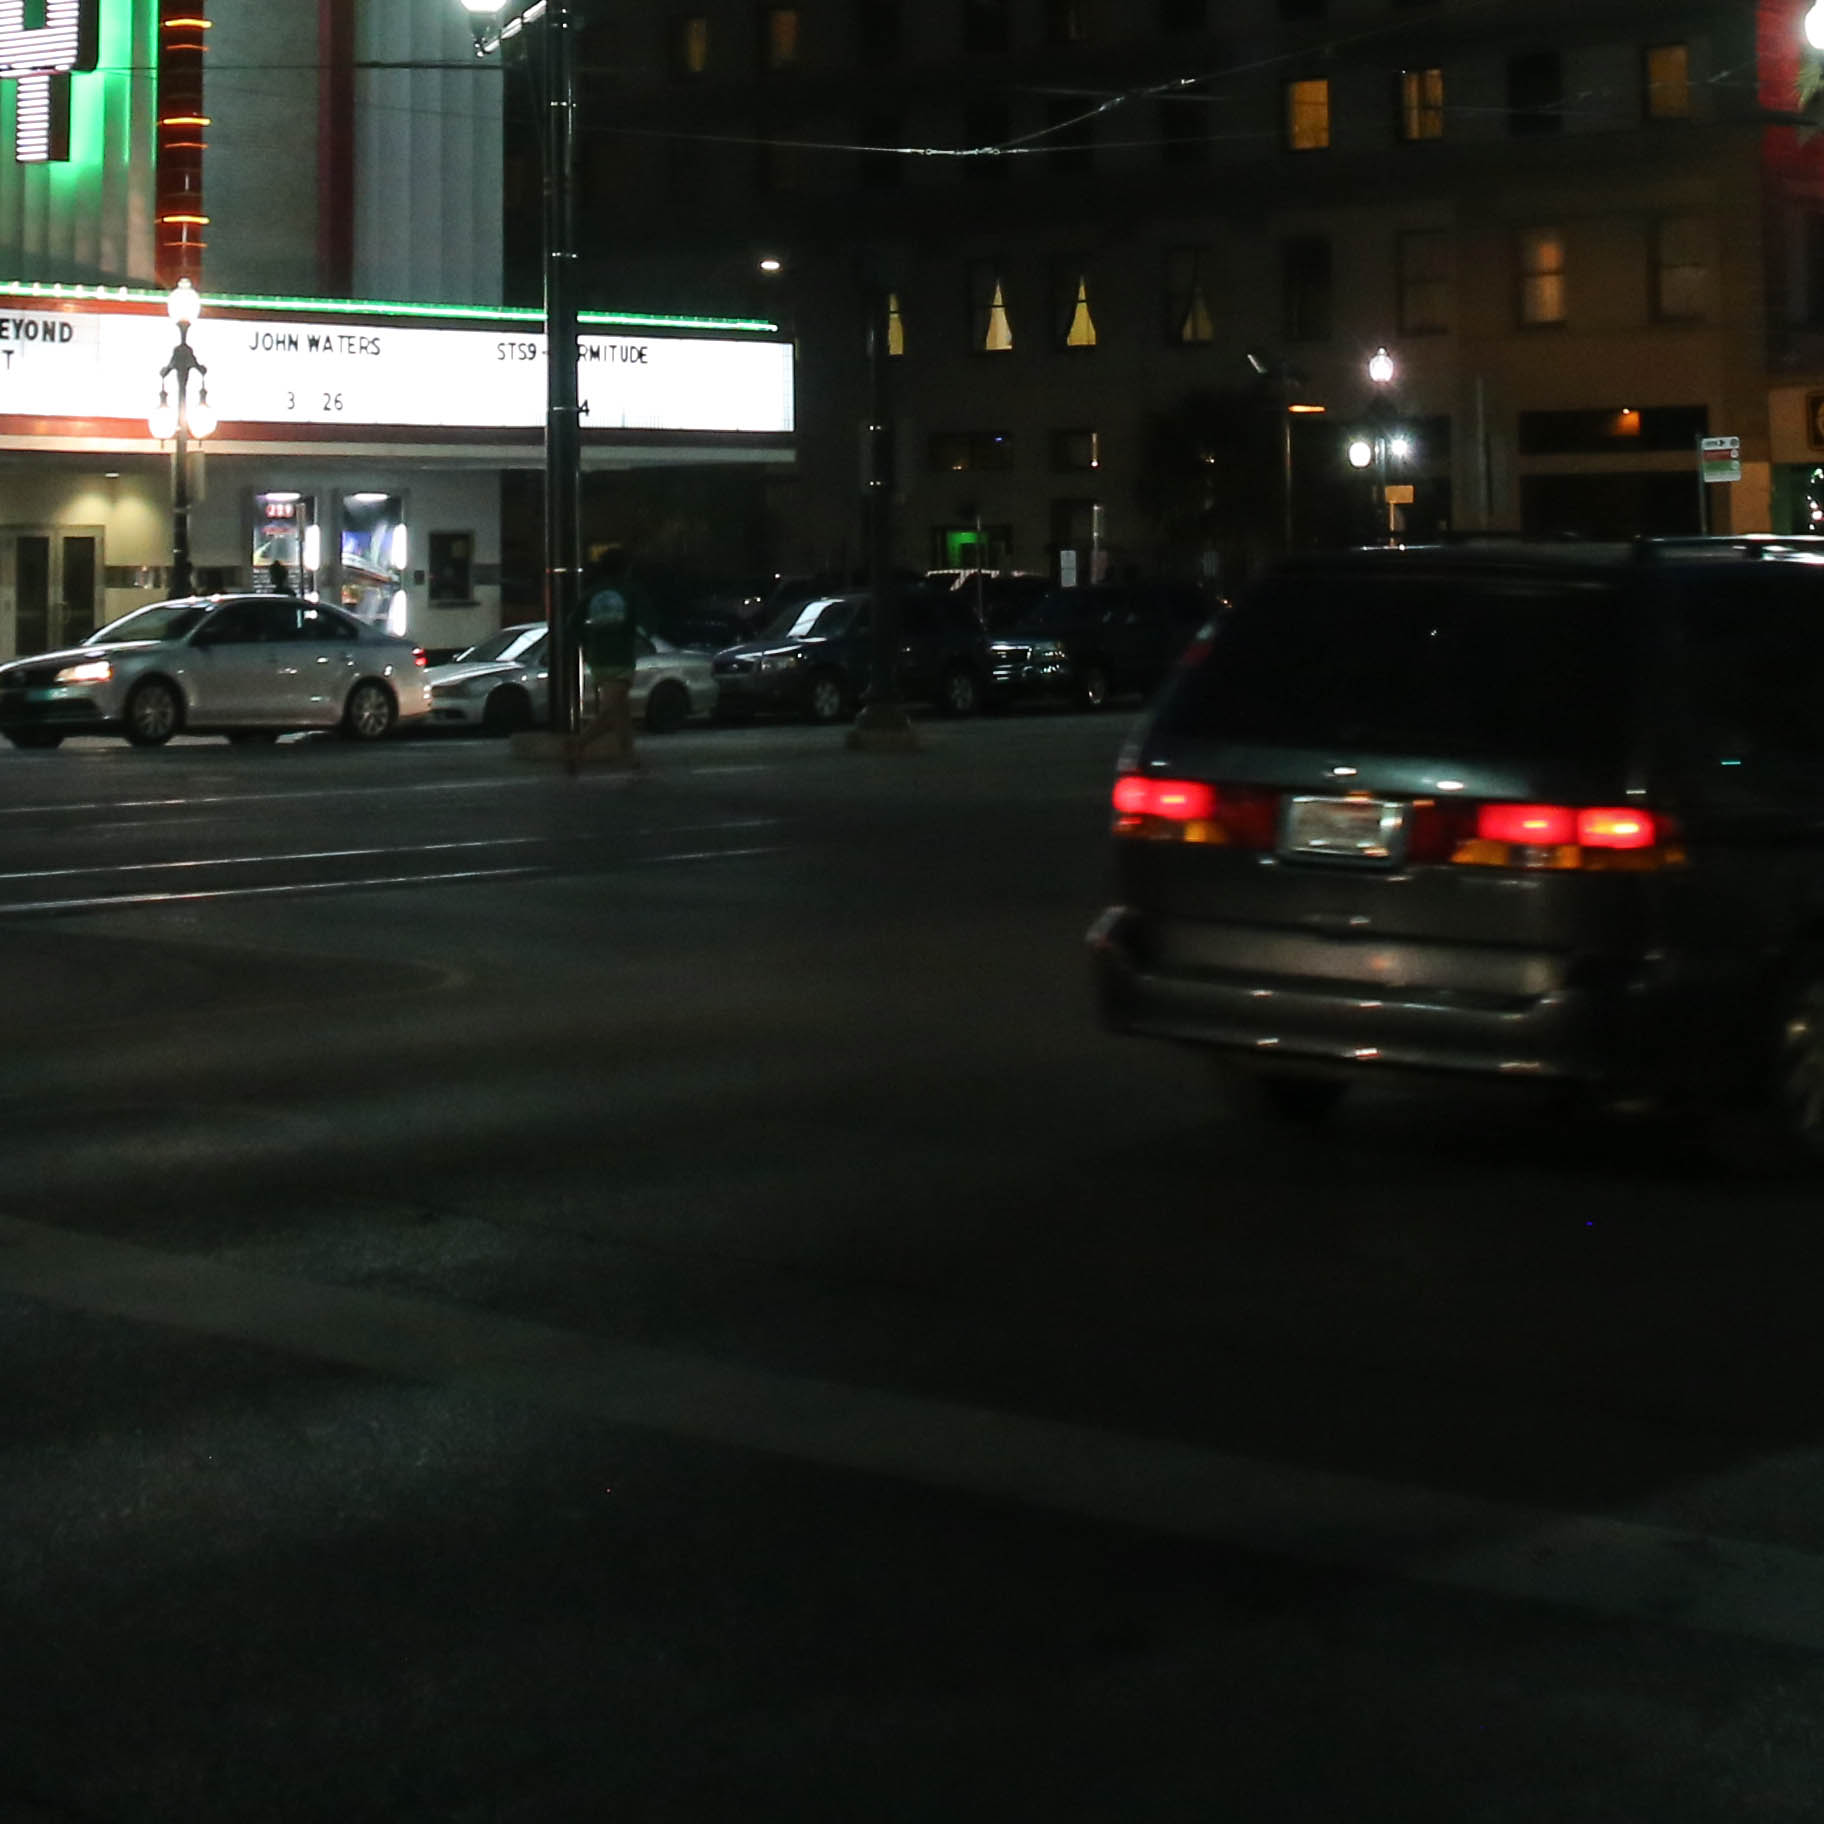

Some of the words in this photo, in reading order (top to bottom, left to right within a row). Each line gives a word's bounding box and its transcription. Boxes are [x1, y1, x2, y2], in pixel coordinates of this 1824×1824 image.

[248, 331, 300, 353] JOHN
[307, 333, 382, 357] WATERS
[496, 341, 538, 361] STS9
[577, 342, 649, 365] RMITUDE
[287, 391, 296, 411] 3
[322, 392, 345, 412] 26
